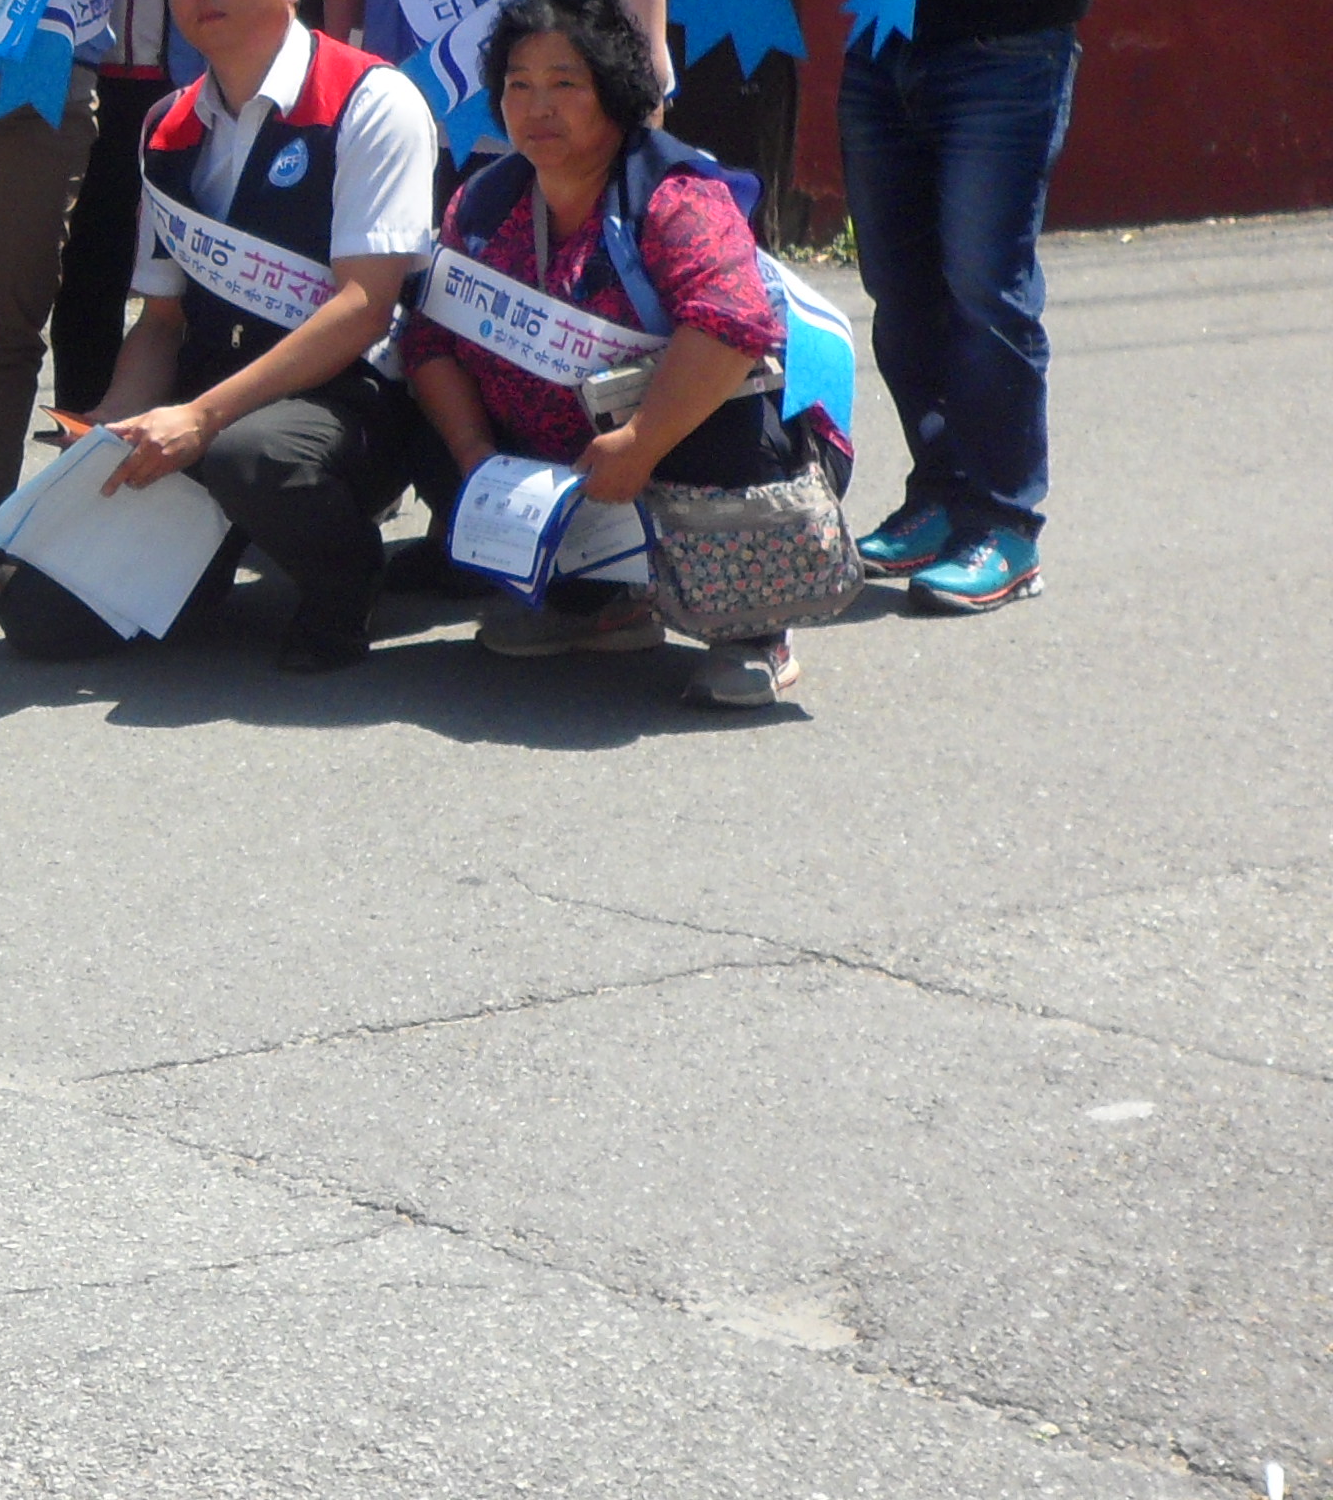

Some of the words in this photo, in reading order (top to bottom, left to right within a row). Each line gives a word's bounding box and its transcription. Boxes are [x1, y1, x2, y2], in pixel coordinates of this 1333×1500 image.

[188, 226, 237, 267] 달아
[445, 264, 512, 321] 태극기를
[511, 297, 550, 338] 달아
